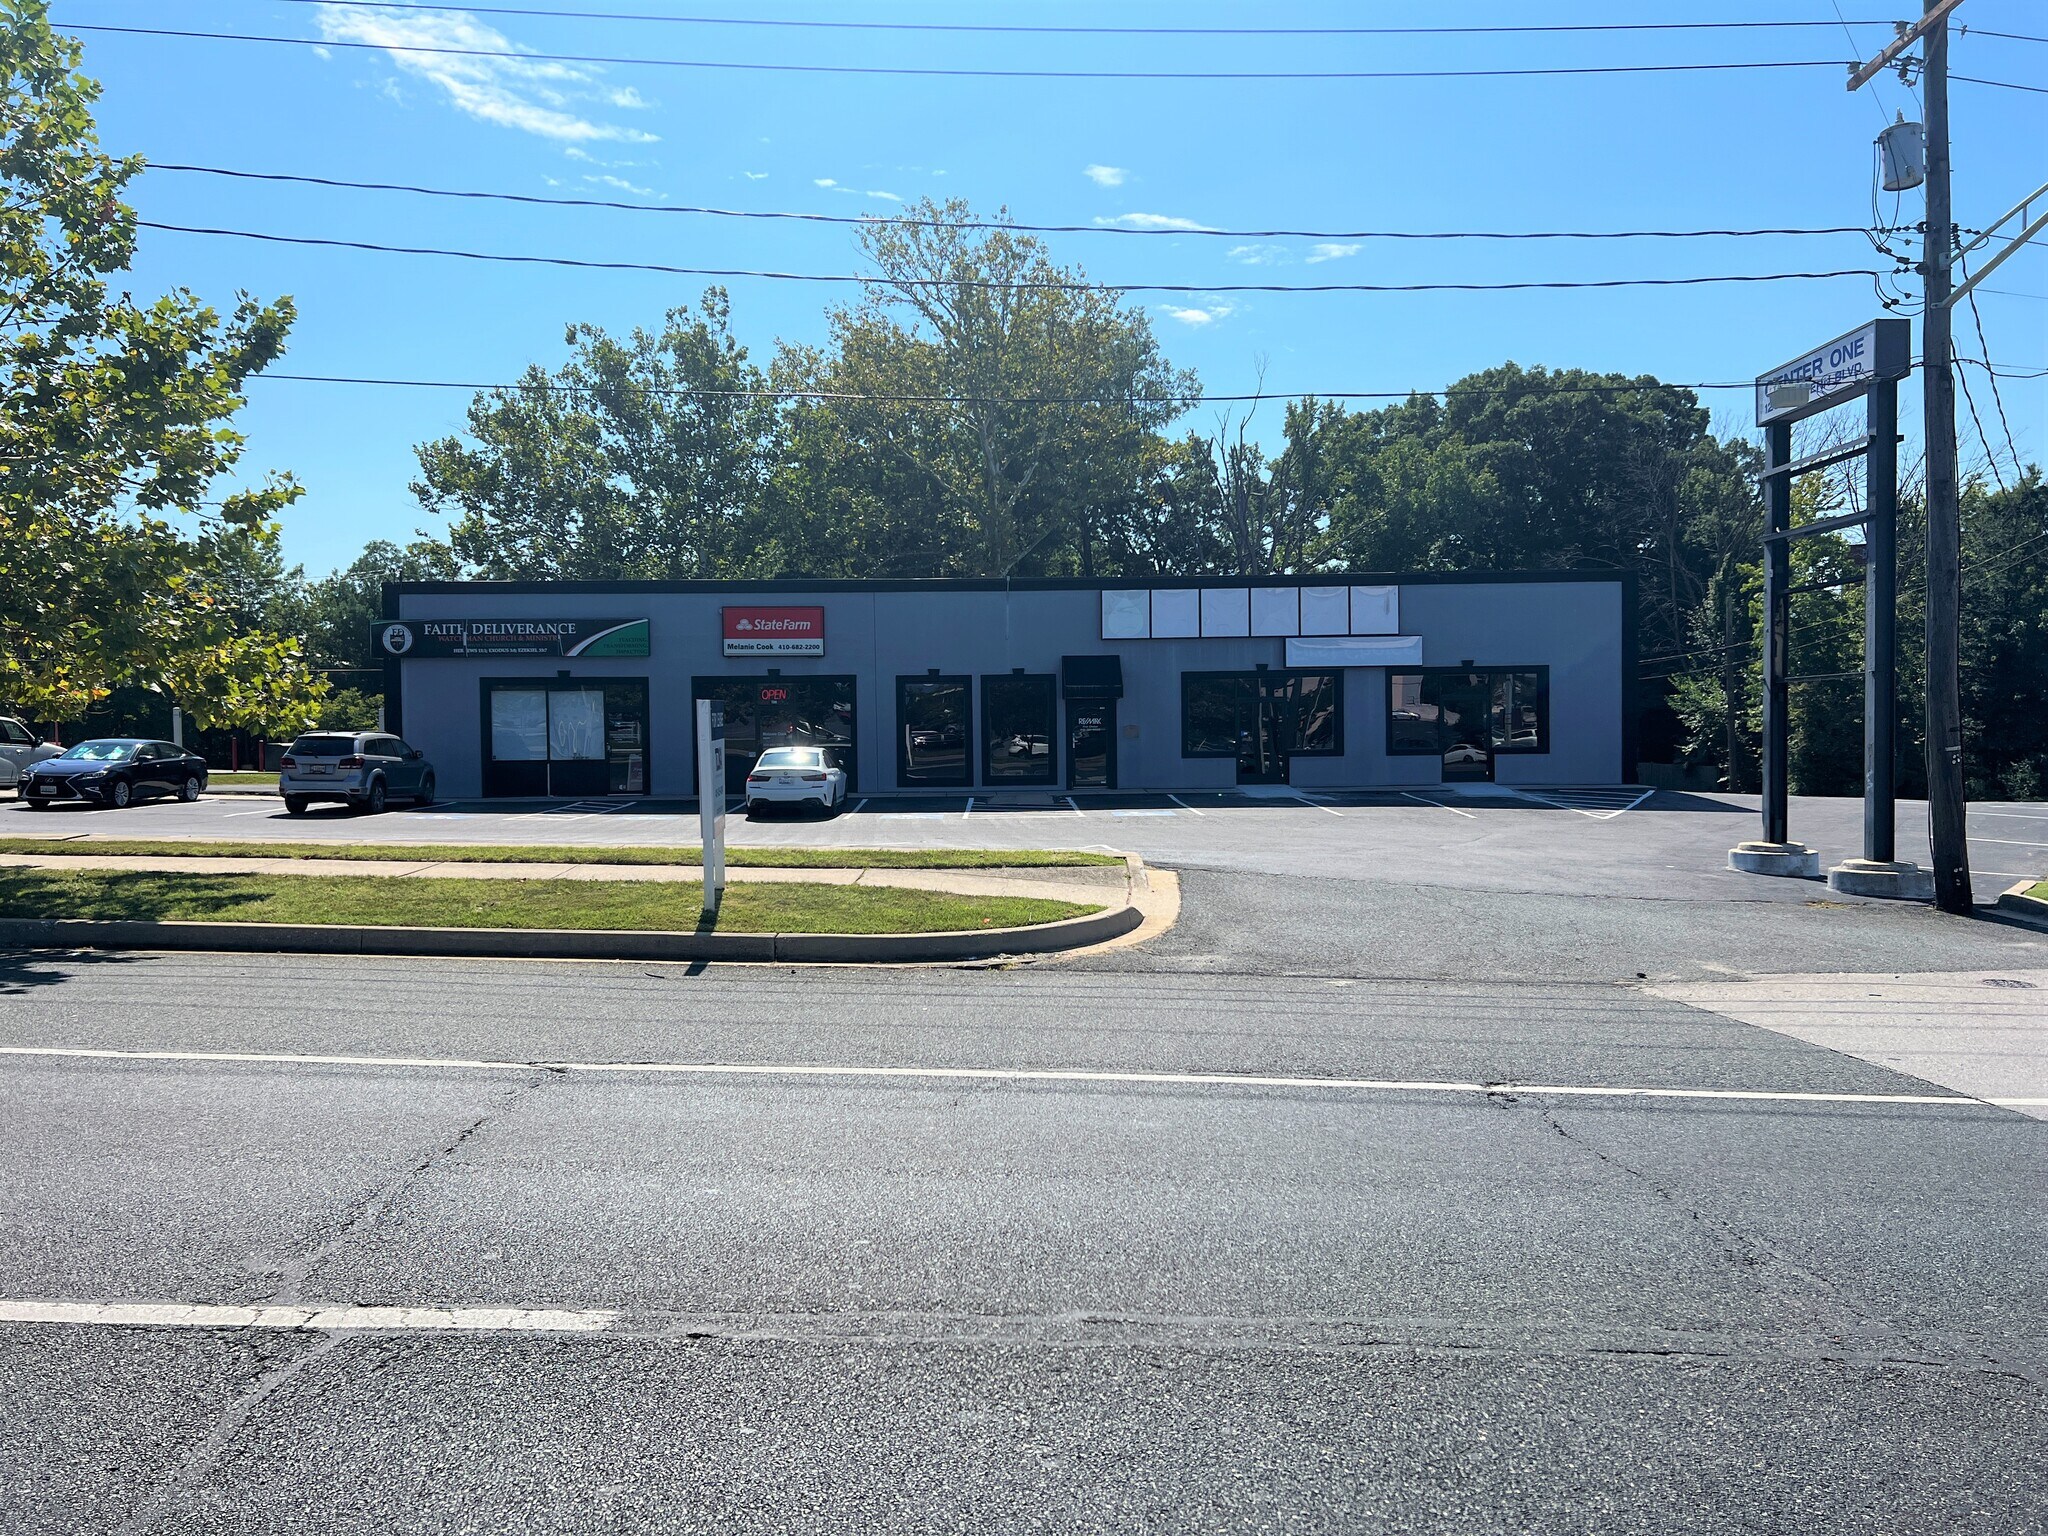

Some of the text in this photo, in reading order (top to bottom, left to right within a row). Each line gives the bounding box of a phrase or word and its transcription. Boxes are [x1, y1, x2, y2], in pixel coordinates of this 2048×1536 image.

[1830, 336, 1865, 368] ONE
[423, 623, 577, 635] FAITH DELIVERANCE
[484, 634, 517, 642] CHURCH
[526, 634, 560, 642] MINISTR
[761, 689, 786, 700] OPEN
